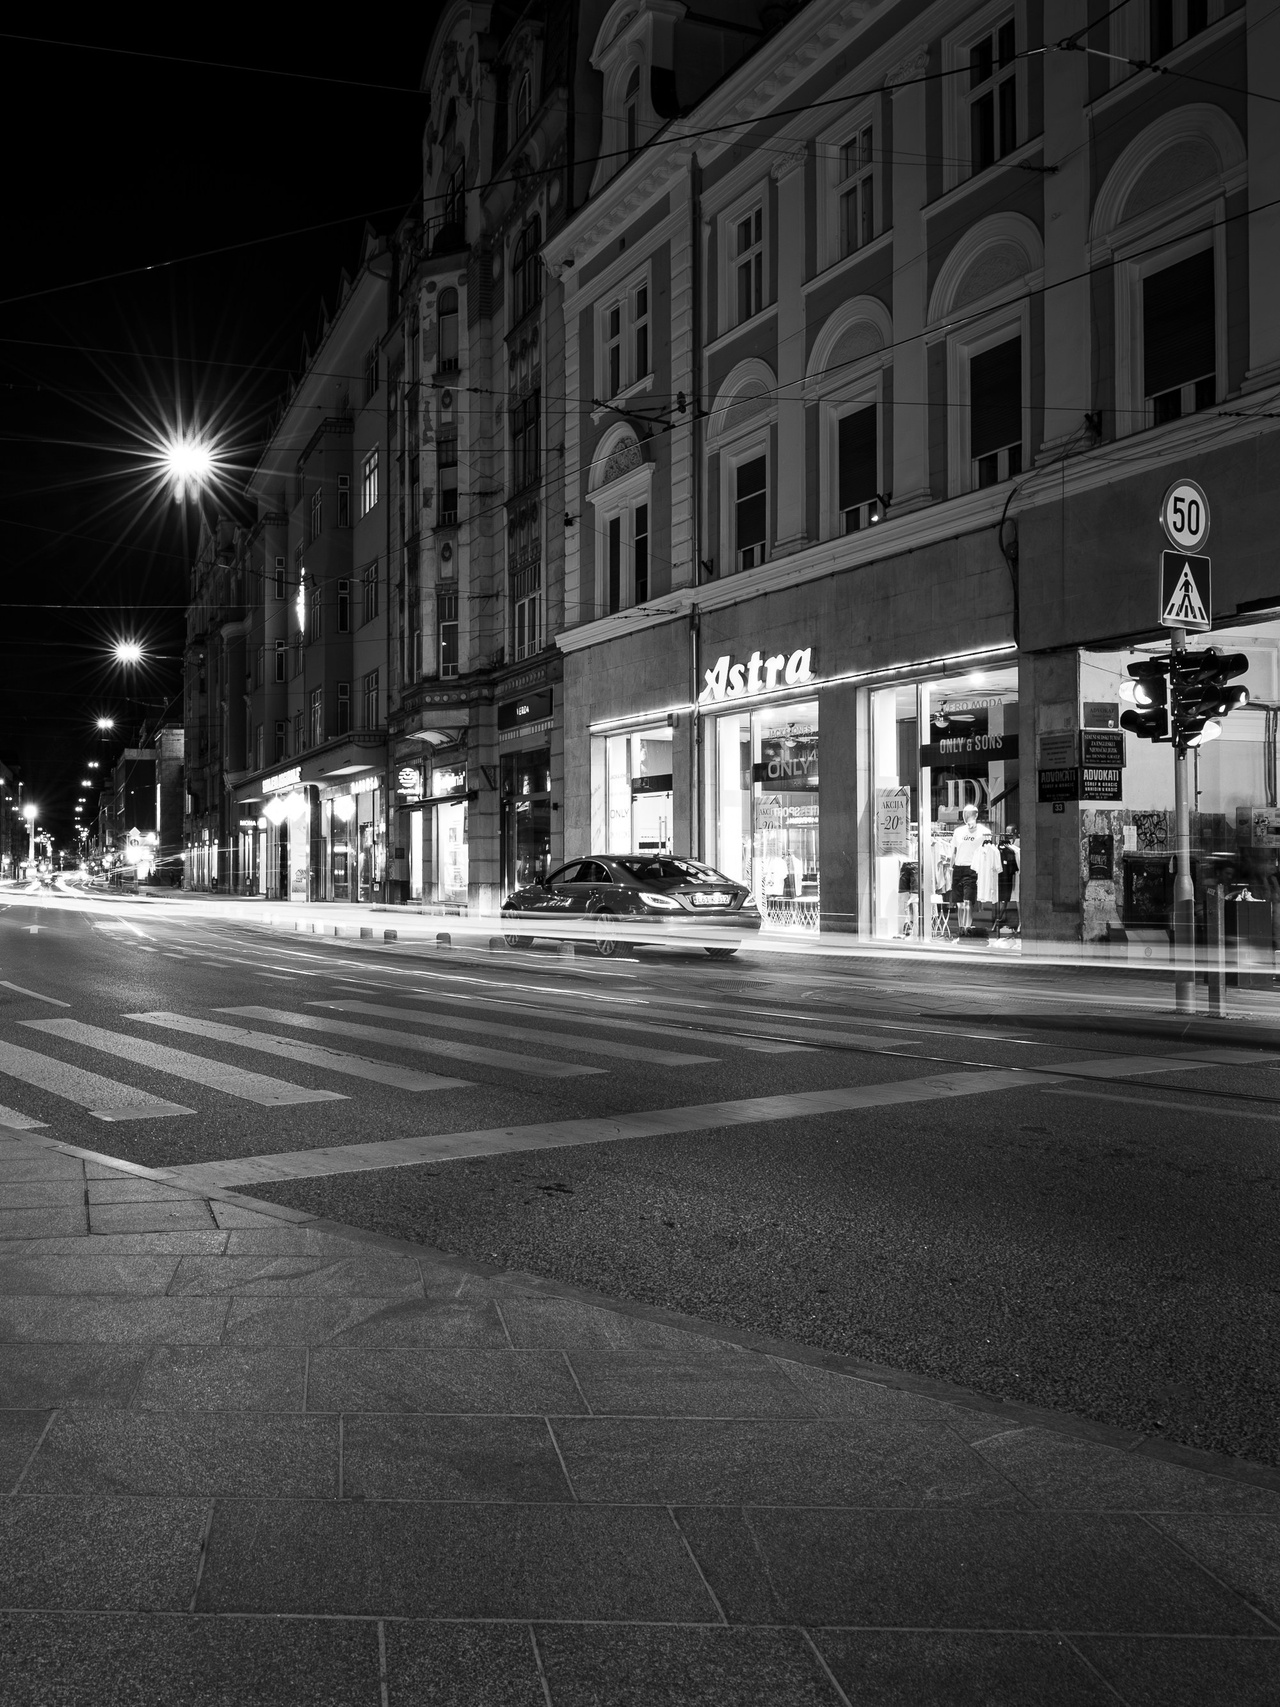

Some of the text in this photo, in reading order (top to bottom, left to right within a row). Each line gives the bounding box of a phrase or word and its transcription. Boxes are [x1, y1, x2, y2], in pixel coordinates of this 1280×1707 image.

[1173, 496, 1200, 535] 50
[698, 647, 812, 702] Astra
[972, 698, 1003, 710] MODA
[939, 734, 1003, 754] ONLY & SONS
[767, 759, 811, 778] ONLY
[1083, 769, 1119, 781] ADVOKATI
[1041, 769, 1076, 783] ADVOKATI
[881, 800, 904, 810] AKCIJA
[1054, 803, 1063, 812] 33
